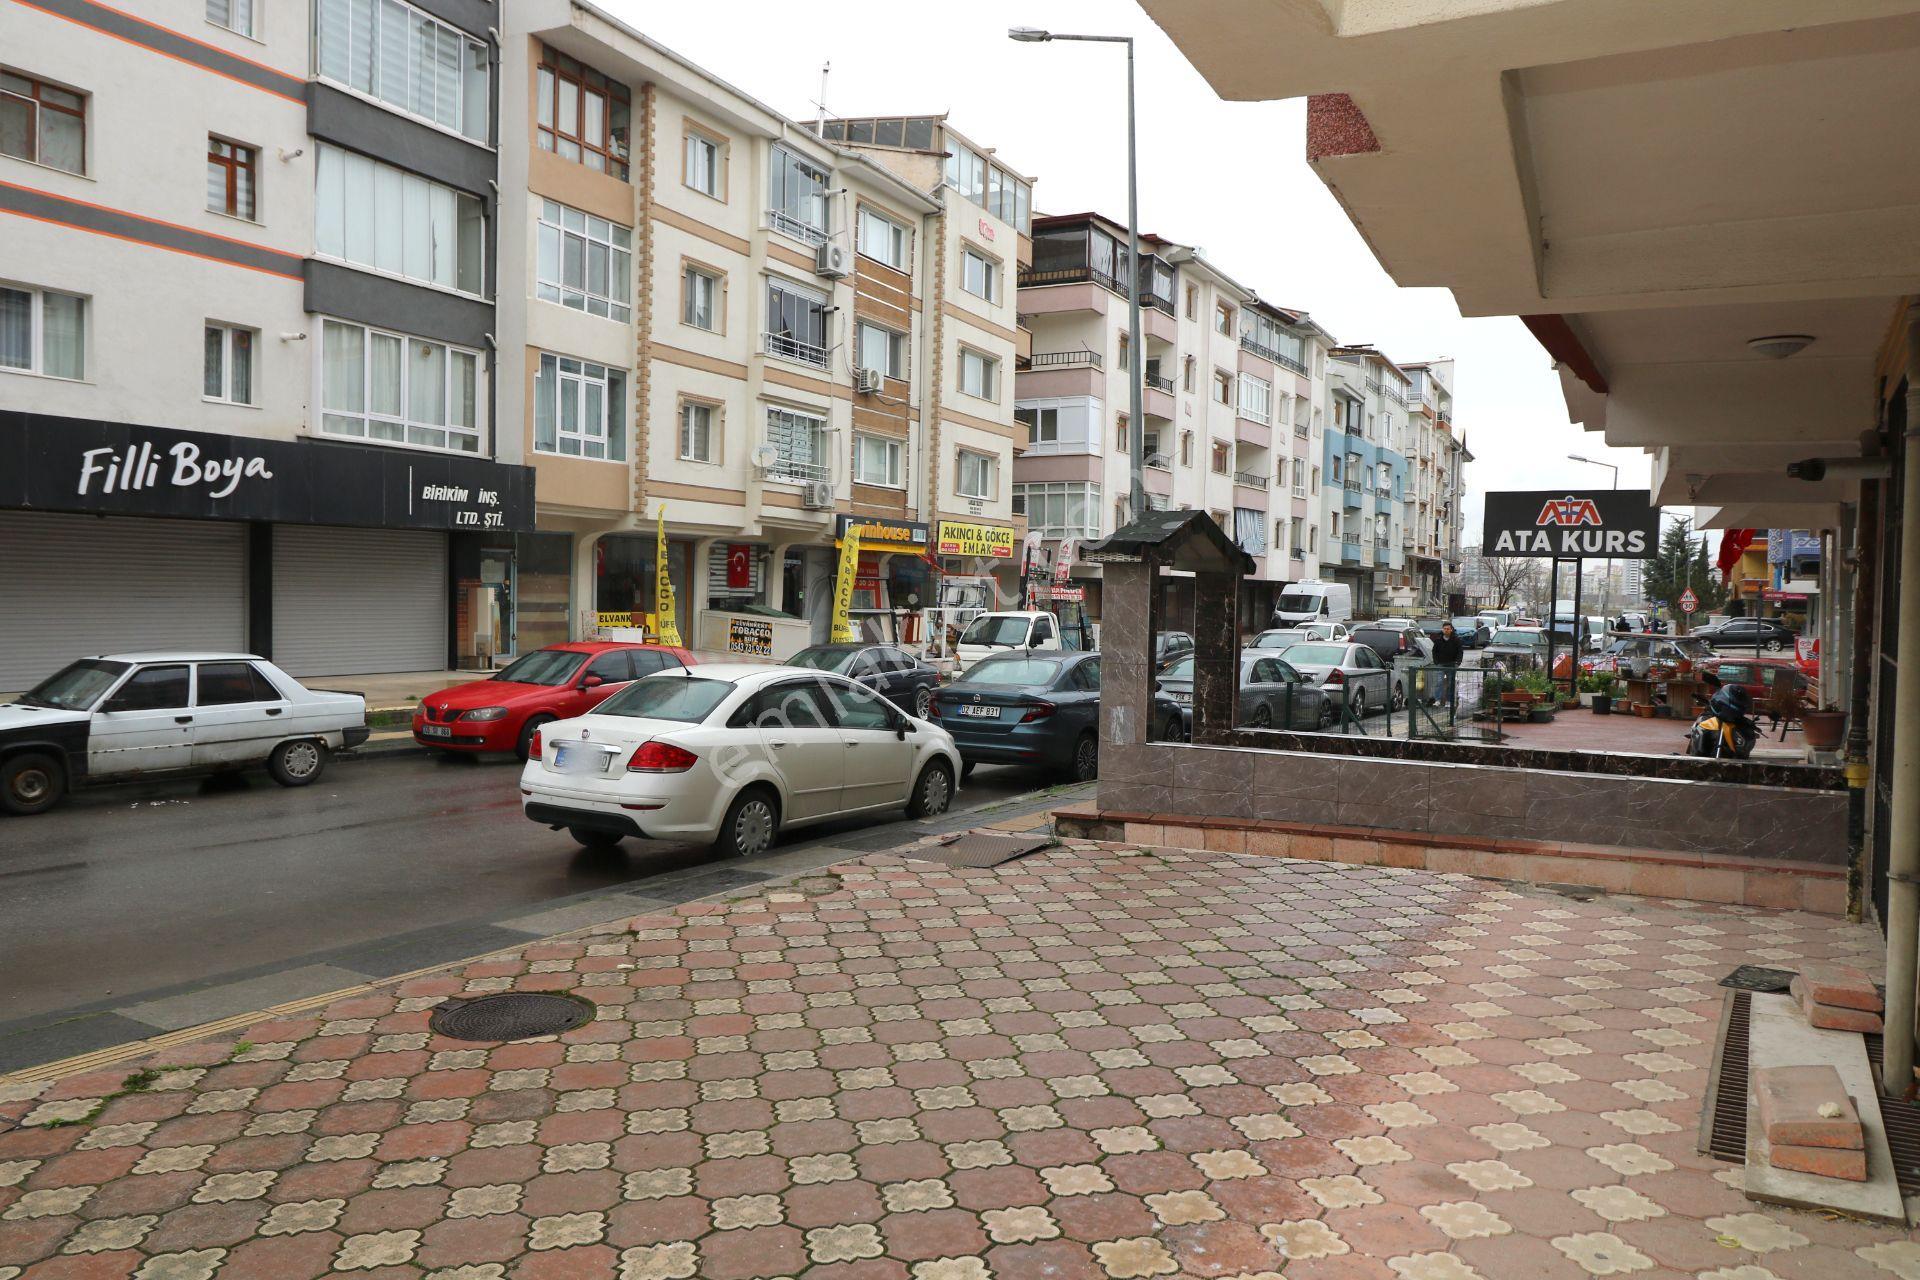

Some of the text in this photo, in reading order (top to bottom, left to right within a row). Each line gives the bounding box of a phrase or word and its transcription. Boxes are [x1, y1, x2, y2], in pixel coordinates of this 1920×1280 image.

[78, 441, 274, 499] Filli Boya
[422, 484, 500, 507] BİRİKİM İNŞ.
[456, 511, 505, 529] LTD. ŞTİ.
[943, 526, 1010, 547] AKINCI & GÖKÇE
[1494, 530, 1646, 553] ATA KURS
[963, 541, 992, 555] EMLAK
[1683, 602, 1693, 610] 30
[599, 614, 632, 623] ELVANK
[732, 625, 771, 638] TOBACCO
